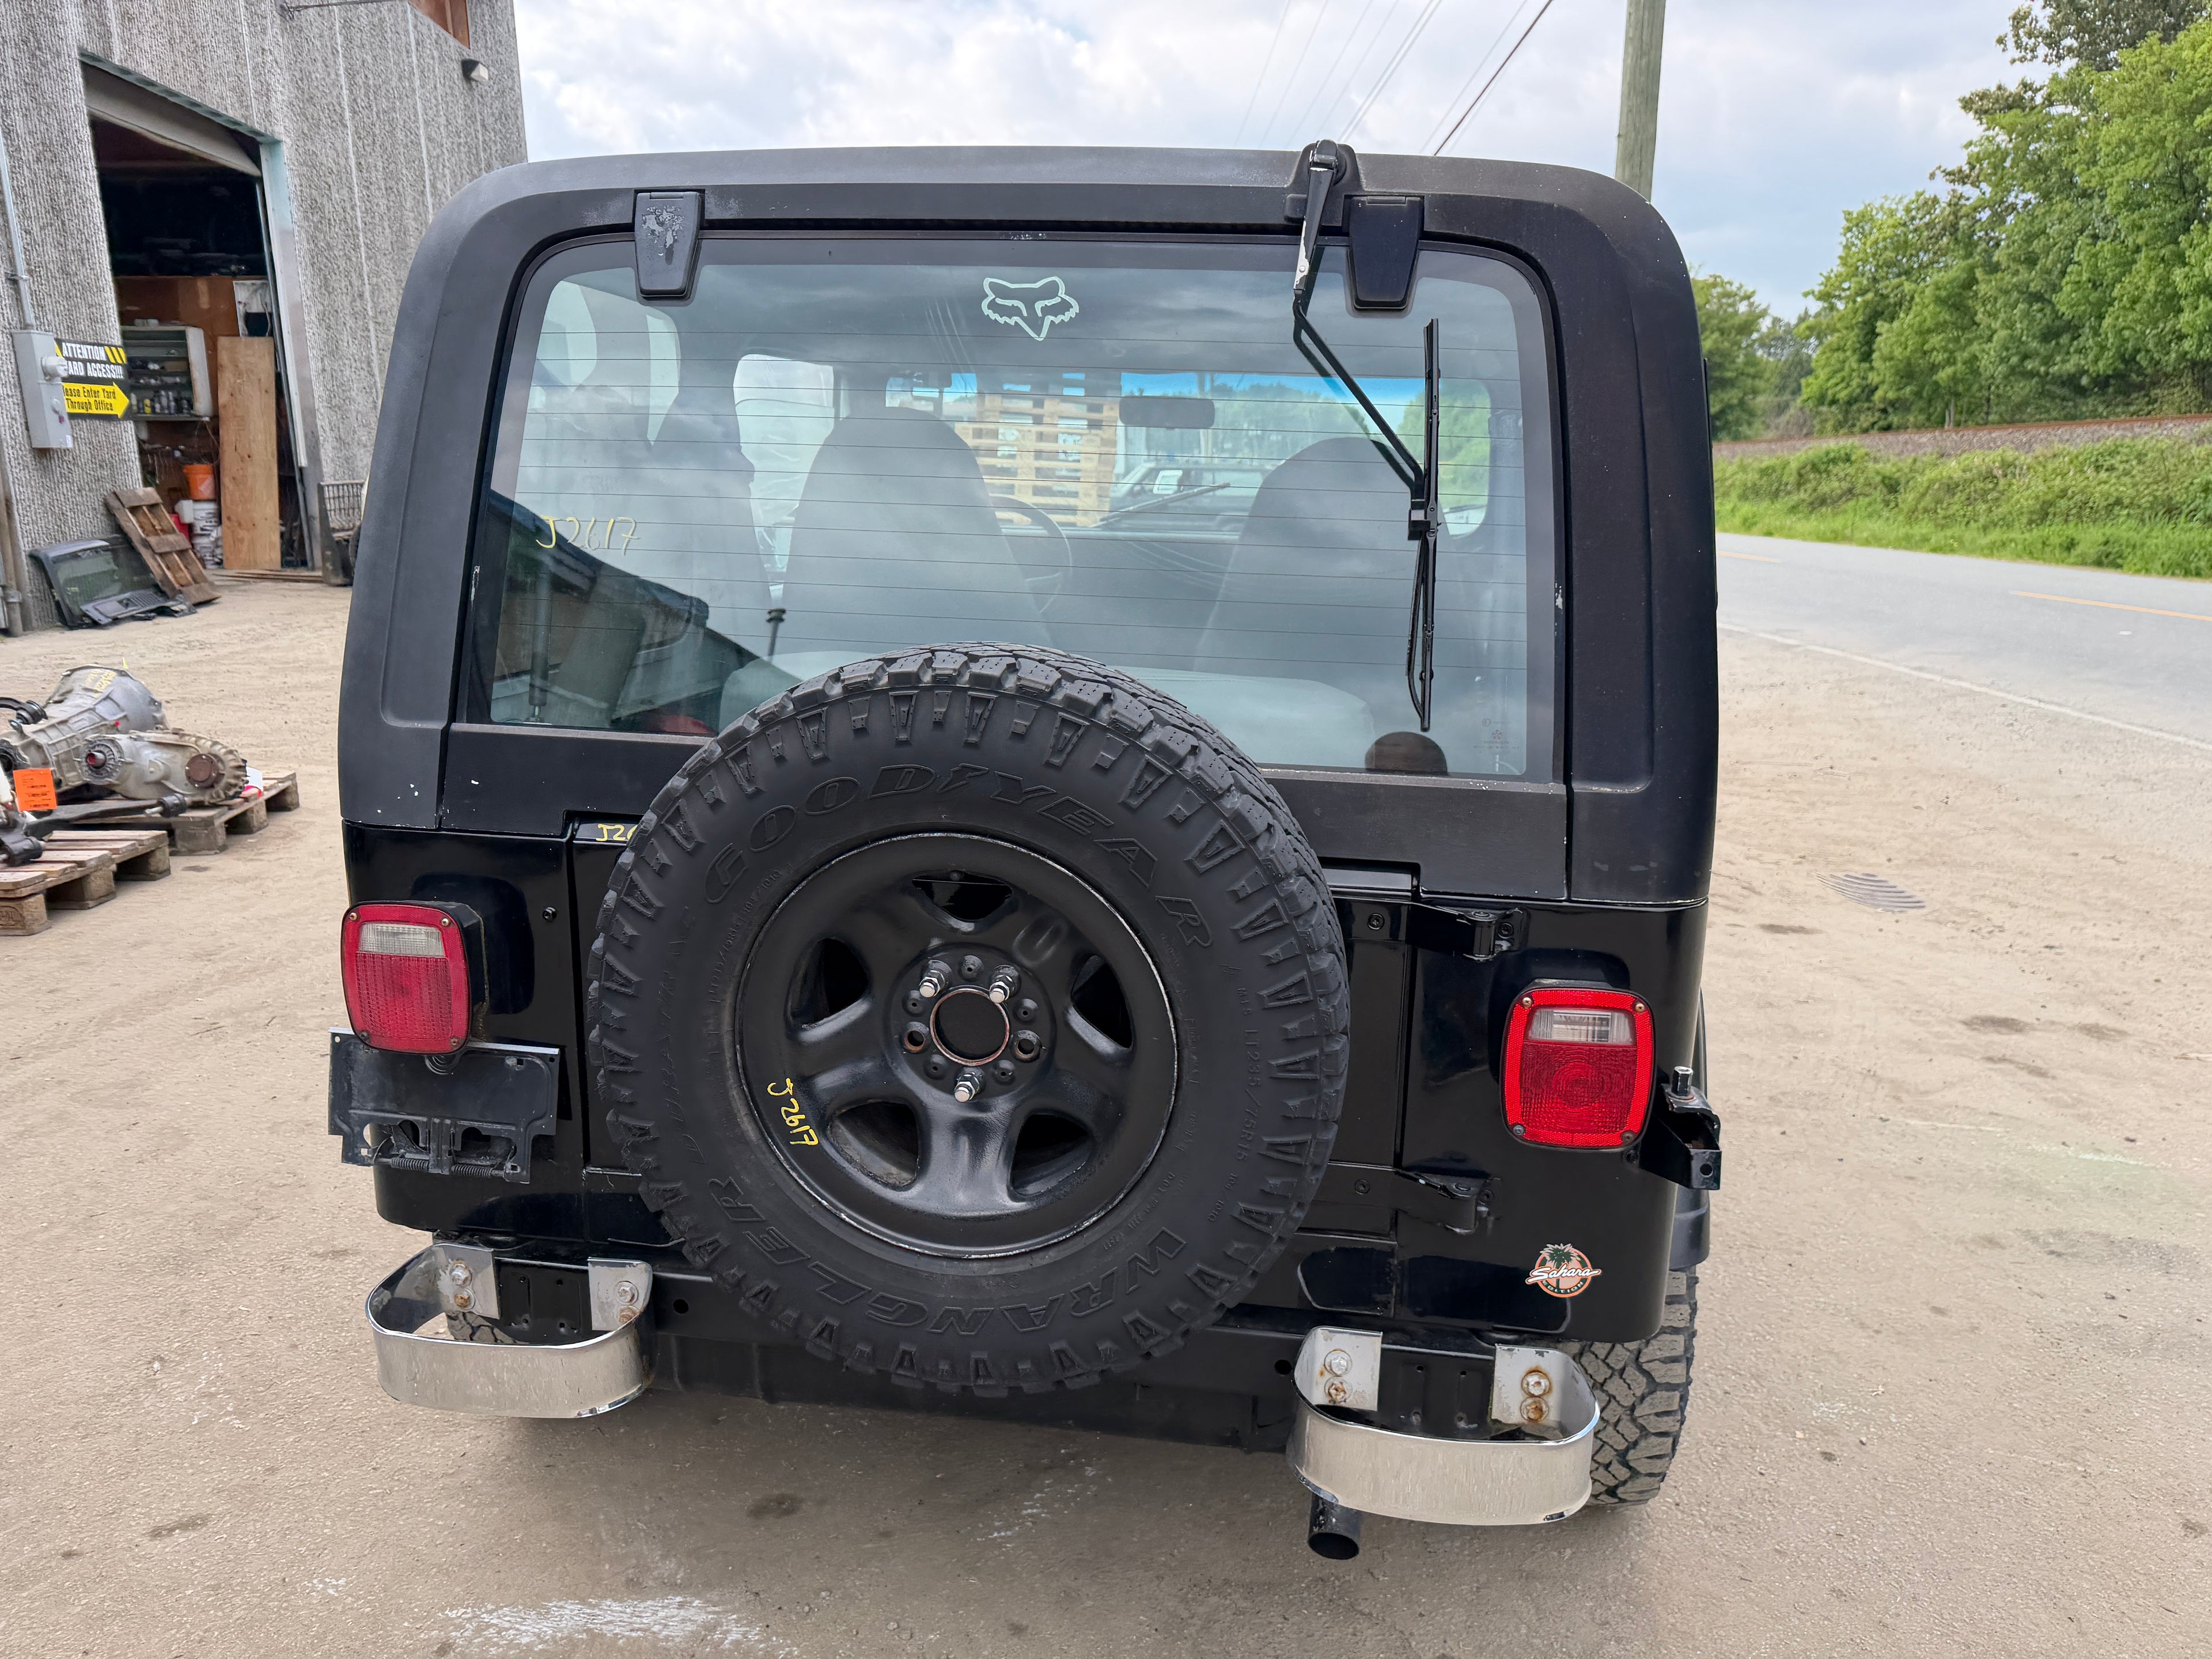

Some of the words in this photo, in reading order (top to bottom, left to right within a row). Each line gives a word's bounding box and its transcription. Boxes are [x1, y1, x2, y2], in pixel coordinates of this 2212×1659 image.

[62, 342, 106, 361] ATTENTION
[67, 361, 85, 376] ARD
[87, 362, 124, 378] ACCESS!!!
[63, 387, 81, 397] lease
[82, 387, 100, 399] Enter
[101, 388, 116, 399] Yard
[66, 398, 92, 412] Through
[94, 399, 113, 411] Office
[536, 515, 641, 556] J2617
[703, 764, 1212, 948] GOODYEAR
[767, 1077, 819, 1146] J2617
[708, 1176, 1187, 1335] WRANGLER
[1527, 1263, 1600, 1283] Sahara
